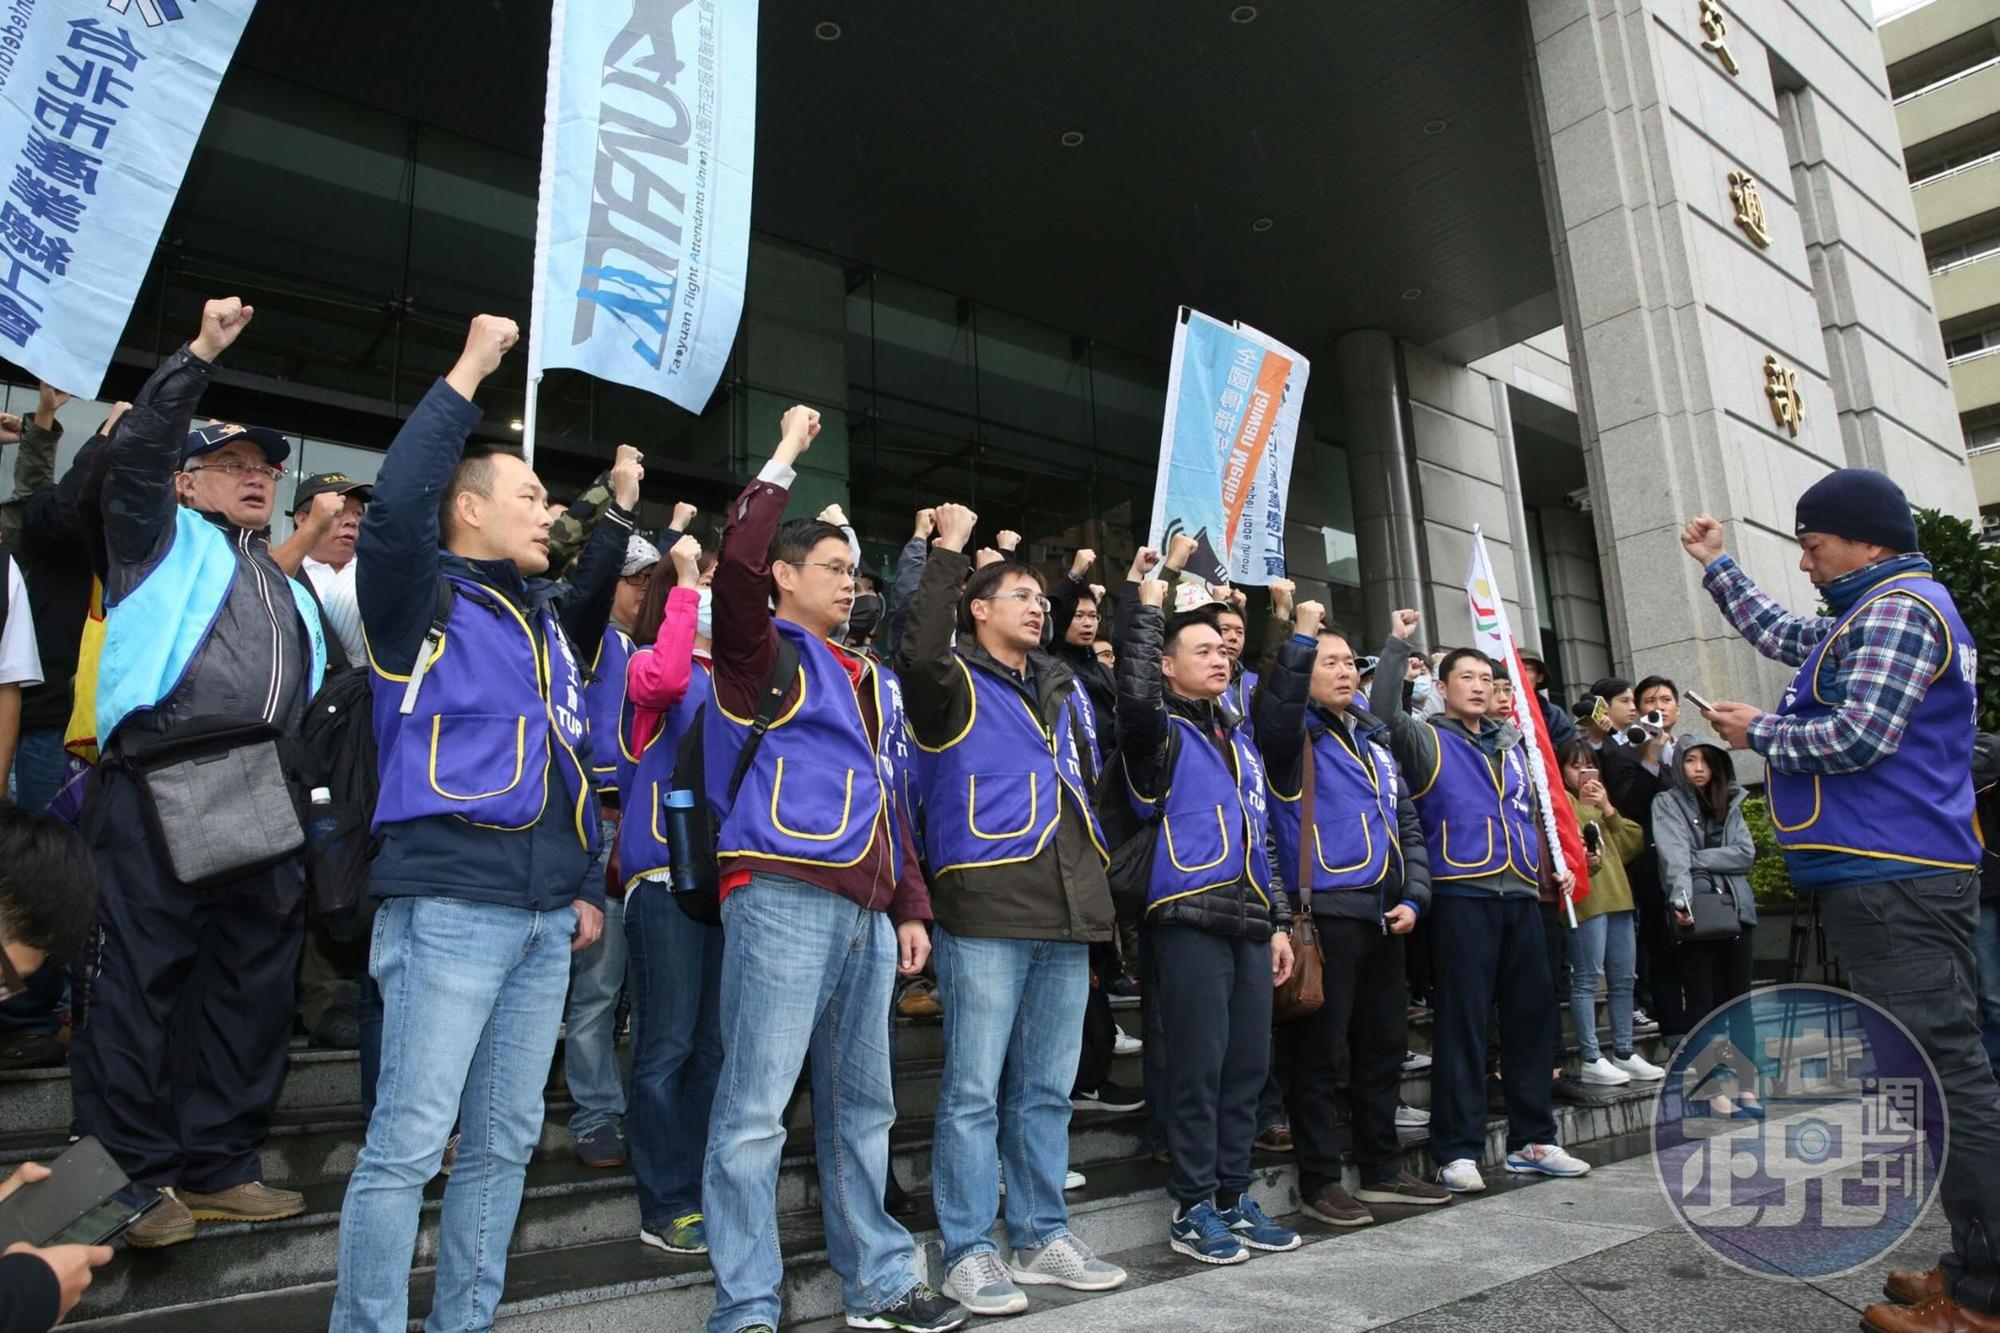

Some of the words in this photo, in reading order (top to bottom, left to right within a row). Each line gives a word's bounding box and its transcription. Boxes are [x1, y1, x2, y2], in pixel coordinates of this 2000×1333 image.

[695, 150, 709, 189] Union
[690, 190, 706, 264] Attendants
[682, 265, 702, 308] Flight
[668, 312, 693, 376] Taoyuan
[556, 704, 583, 739] TUP
